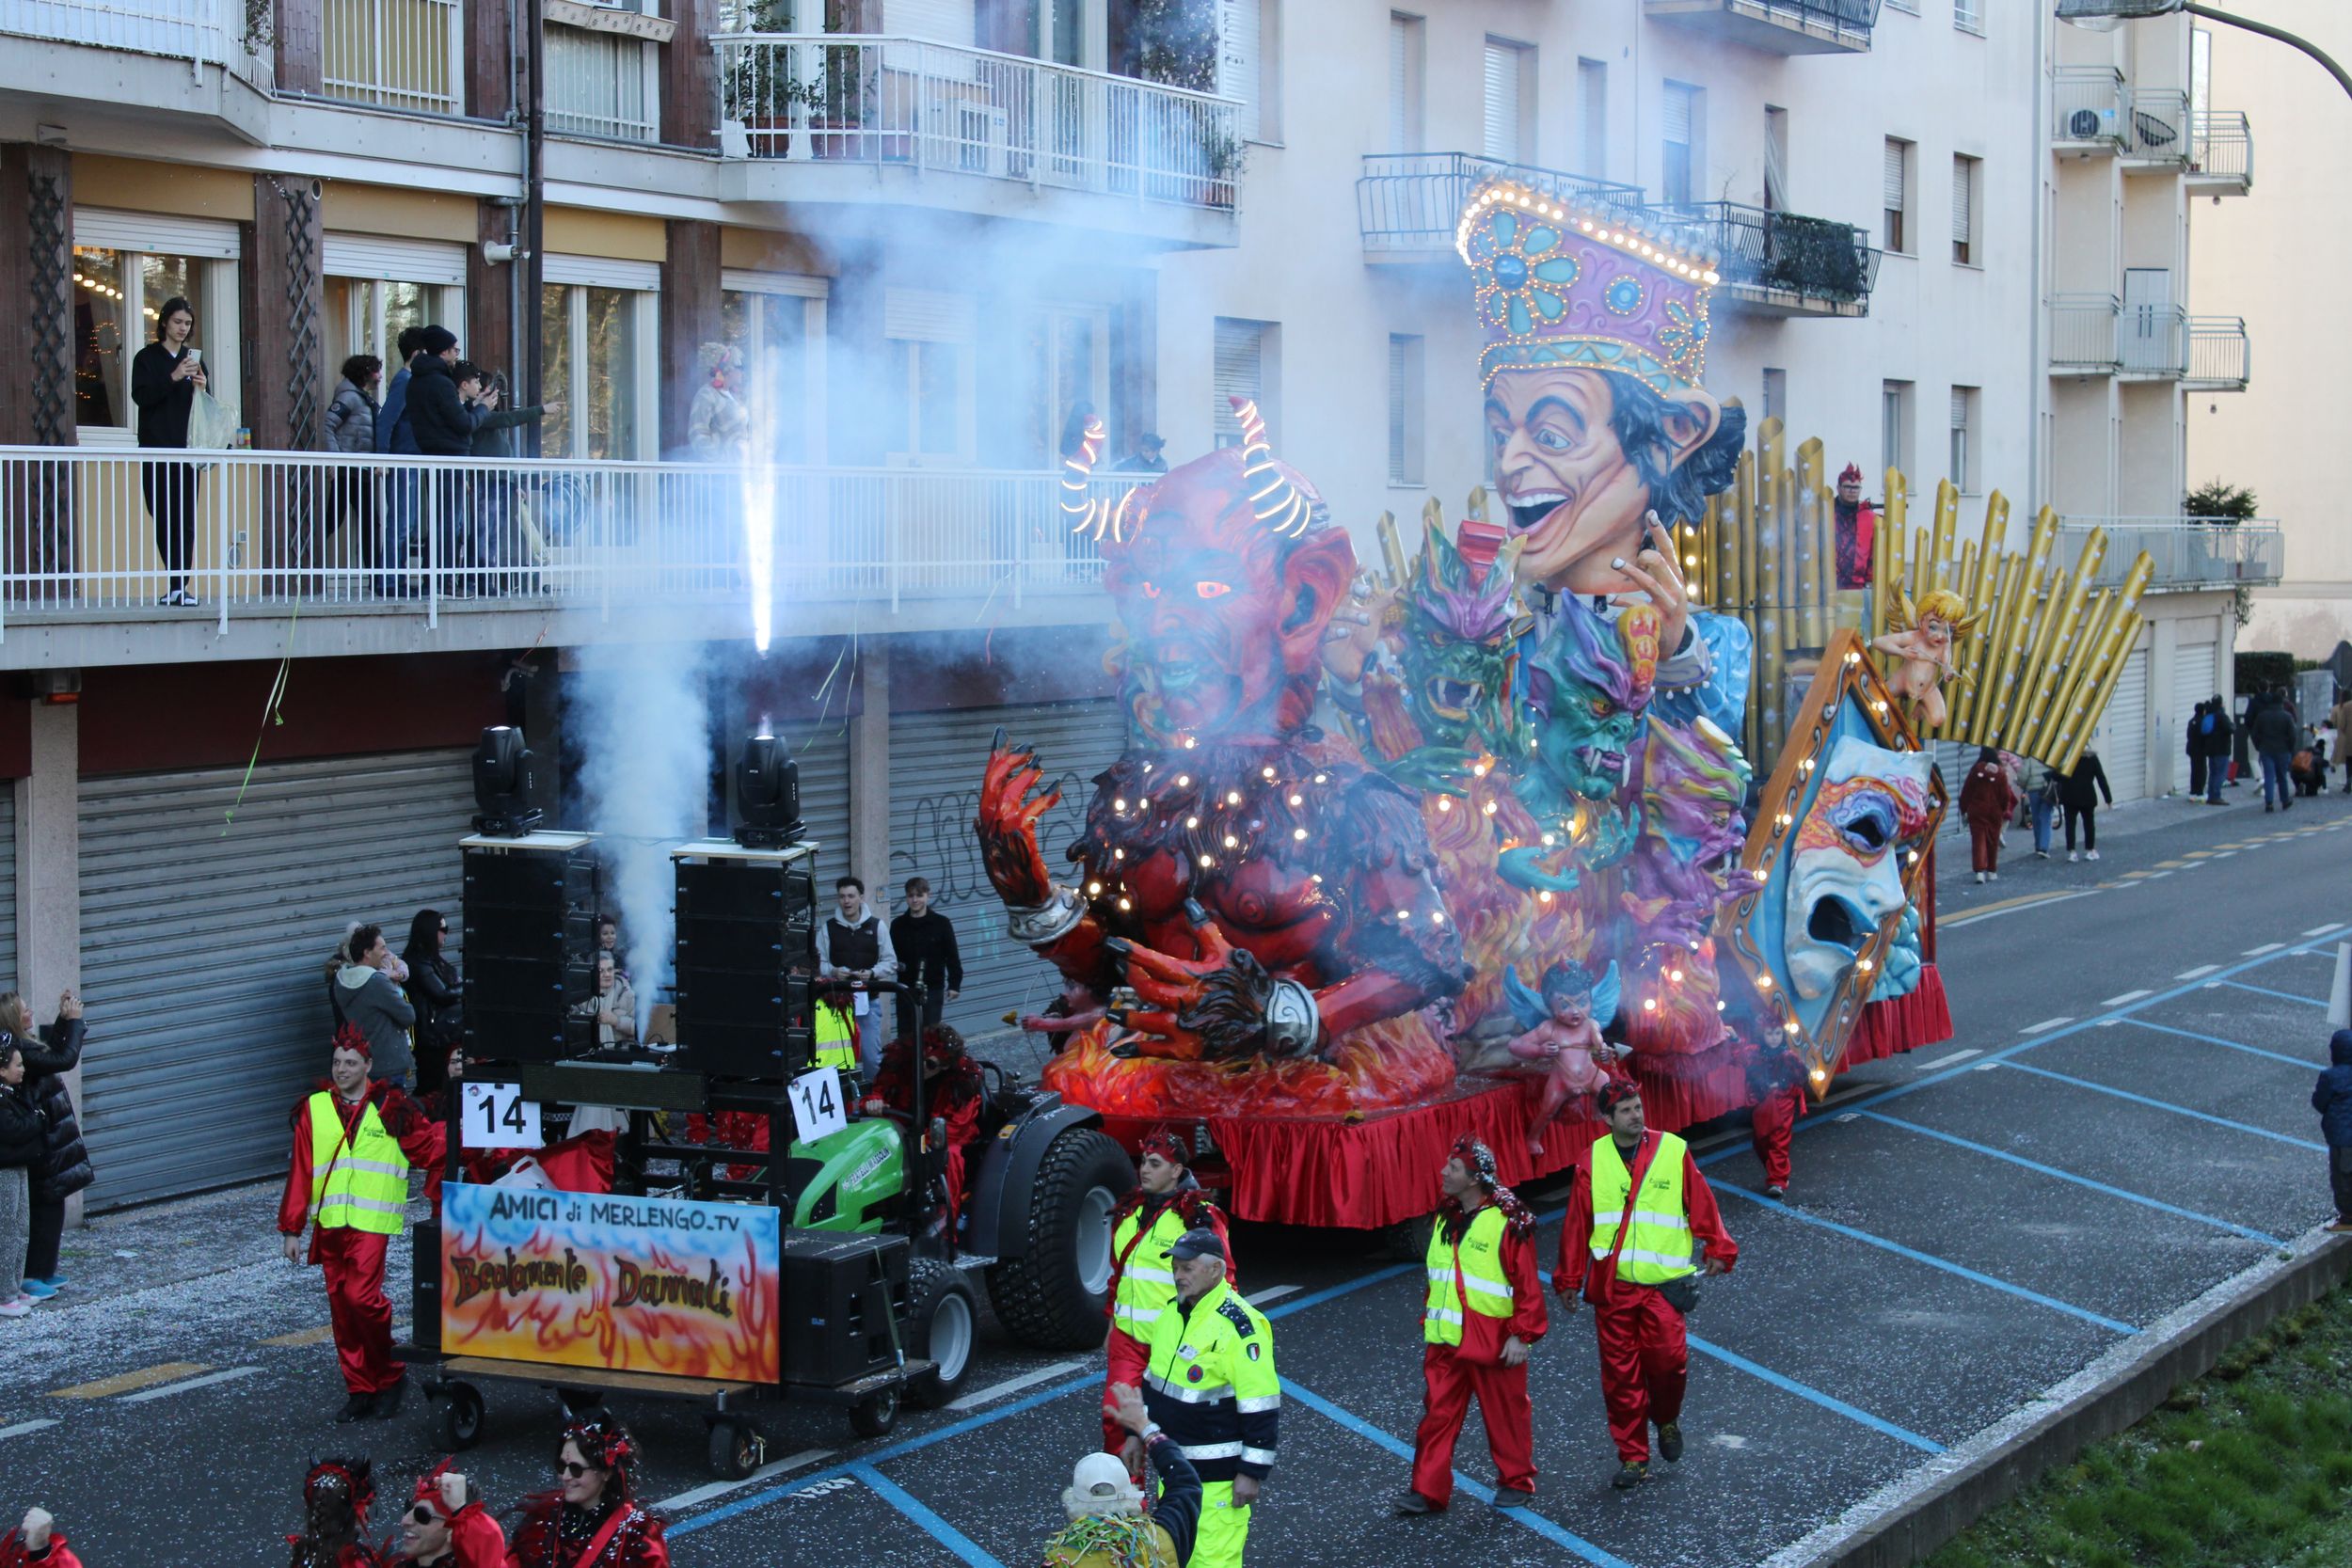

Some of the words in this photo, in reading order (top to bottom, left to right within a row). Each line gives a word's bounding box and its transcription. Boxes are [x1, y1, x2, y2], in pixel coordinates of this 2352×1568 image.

[478, 1095, 527, 1134] 14
[803, 1080, 835, 1125] 14
[489, 1191, 557, 1221] AMICI
[565, 1201, 581, 1222] di
[451, 1246, 587, 1308] Beatamente
[612, 1255, 733, 1319] Dannati
